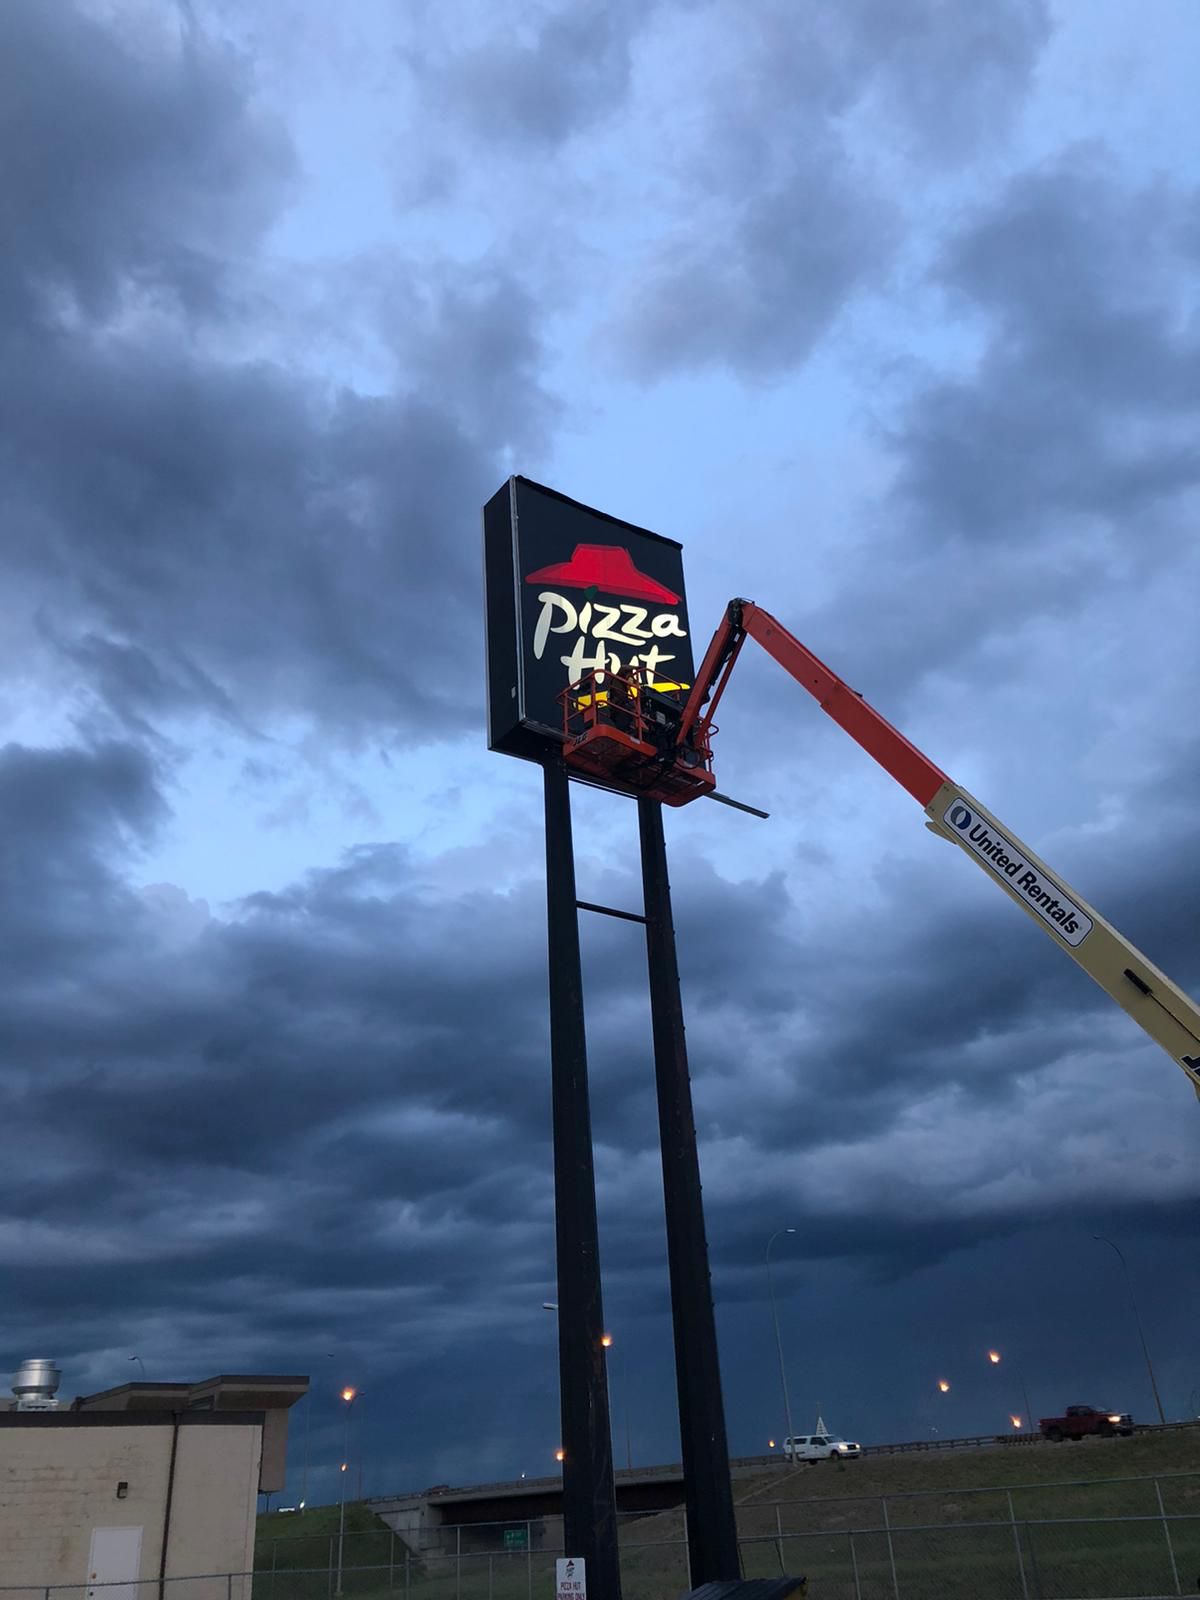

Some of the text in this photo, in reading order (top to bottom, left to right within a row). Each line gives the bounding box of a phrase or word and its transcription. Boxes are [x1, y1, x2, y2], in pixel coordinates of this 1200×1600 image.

[533, 591, 687, 660] Pizza
[969, 824, 1079, 934] United Rentals
